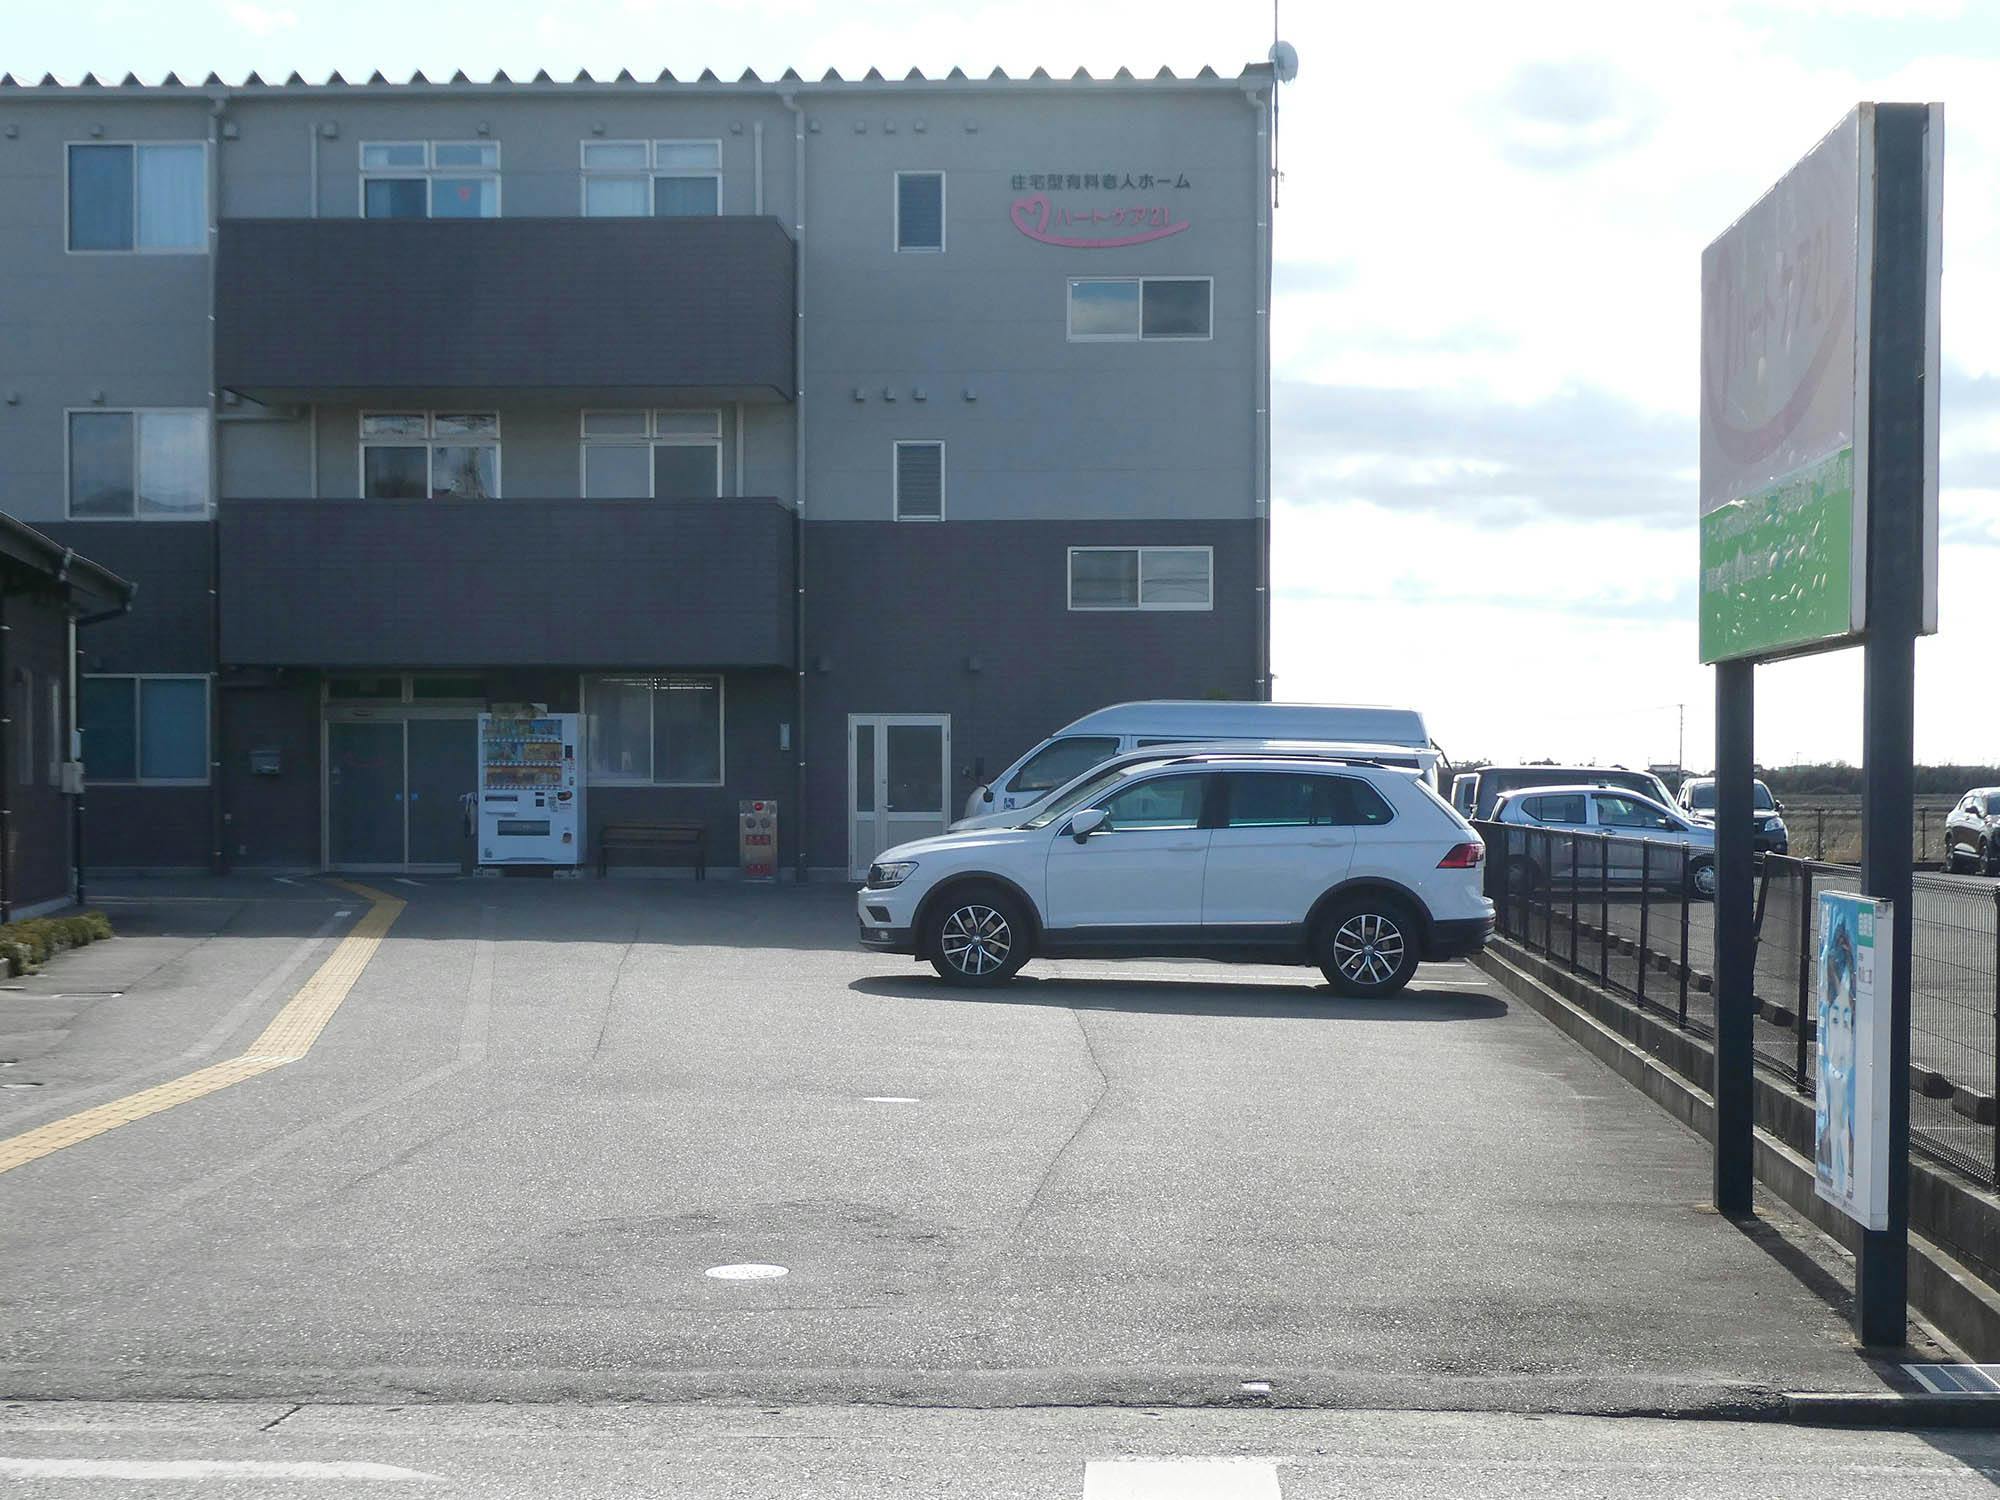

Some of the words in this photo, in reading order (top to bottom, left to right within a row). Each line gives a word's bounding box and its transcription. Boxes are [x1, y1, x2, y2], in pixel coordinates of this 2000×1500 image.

[1011, 173, 1191, 191] 住宅型有料老人ホーム
